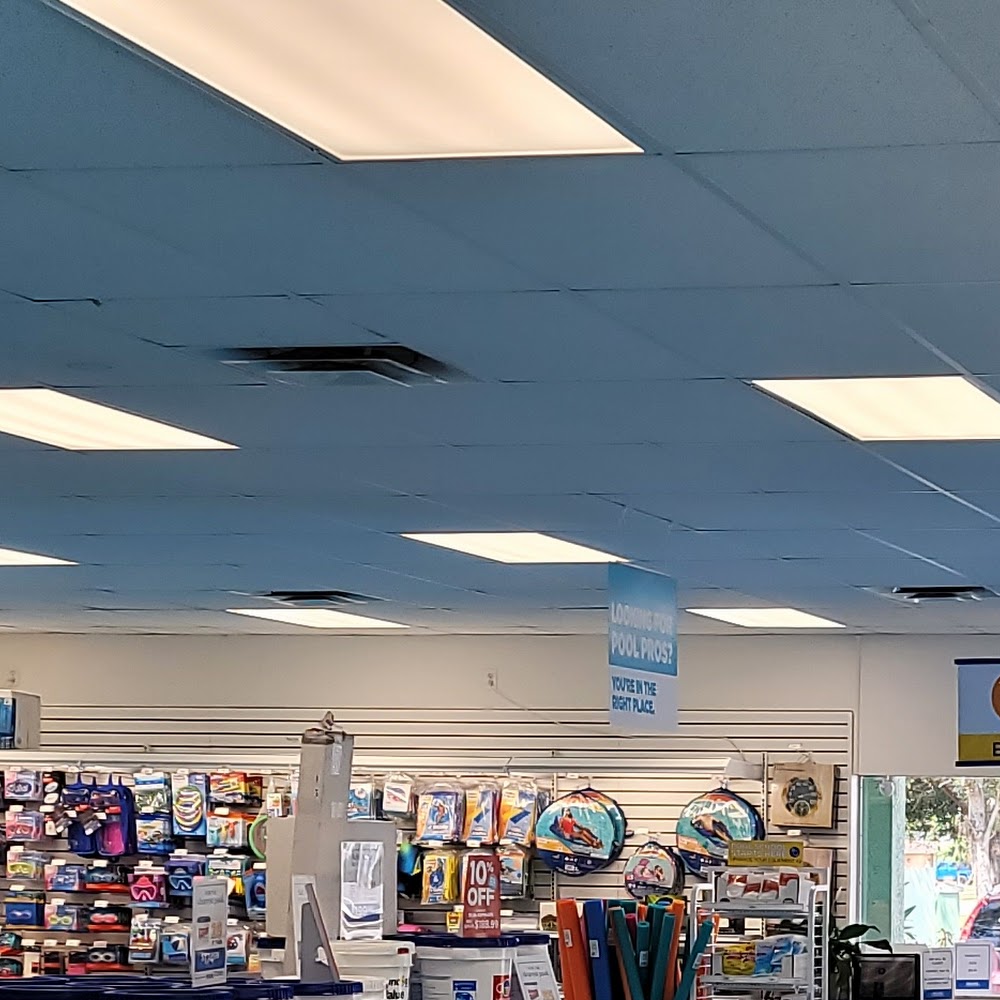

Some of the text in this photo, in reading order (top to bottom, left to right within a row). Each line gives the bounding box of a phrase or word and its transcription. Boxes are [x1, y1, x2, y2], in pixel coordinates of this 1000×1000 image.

[611, 631, 673, 665] POOL PROS?
[644, 681, 657, 697] THE
[612, 694, 631, 711] RIGHT
[469, 860, 494, 886] 10%
[467, 887, 495, 906] OFF
